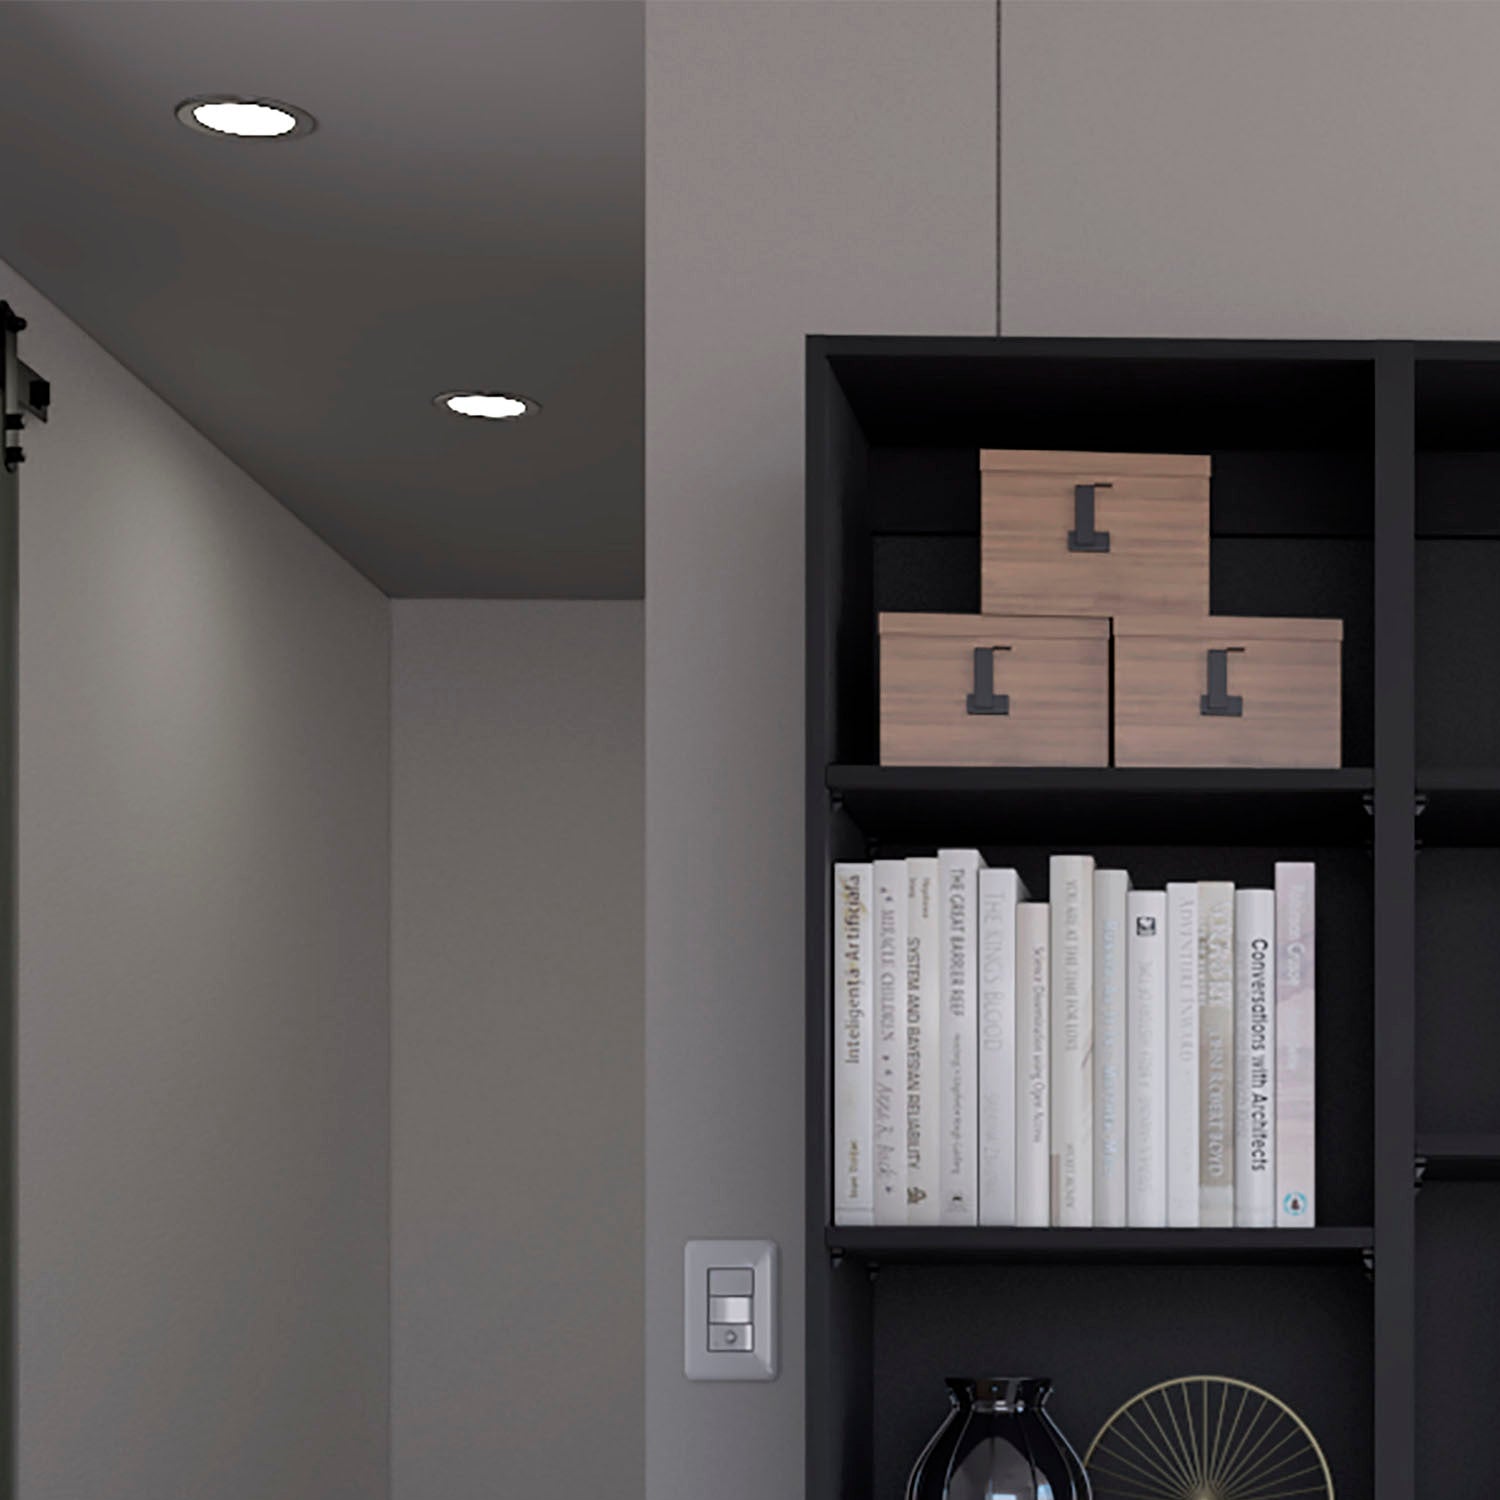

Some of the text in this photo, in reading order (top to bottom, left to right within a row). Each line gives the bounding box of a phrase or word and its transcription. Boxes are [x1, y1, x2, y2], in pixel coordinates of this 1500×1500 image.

[950, 869, 966, 890] THE
[950, 894, 966, 934] GREAT
[950, 937, 966, 982] BARRIER
[906, 937, 920, 1170] SYSTEM AND BAYESIAN RELIABILITY
[1251, 938, 1269, 1171] Conversations with Architects
